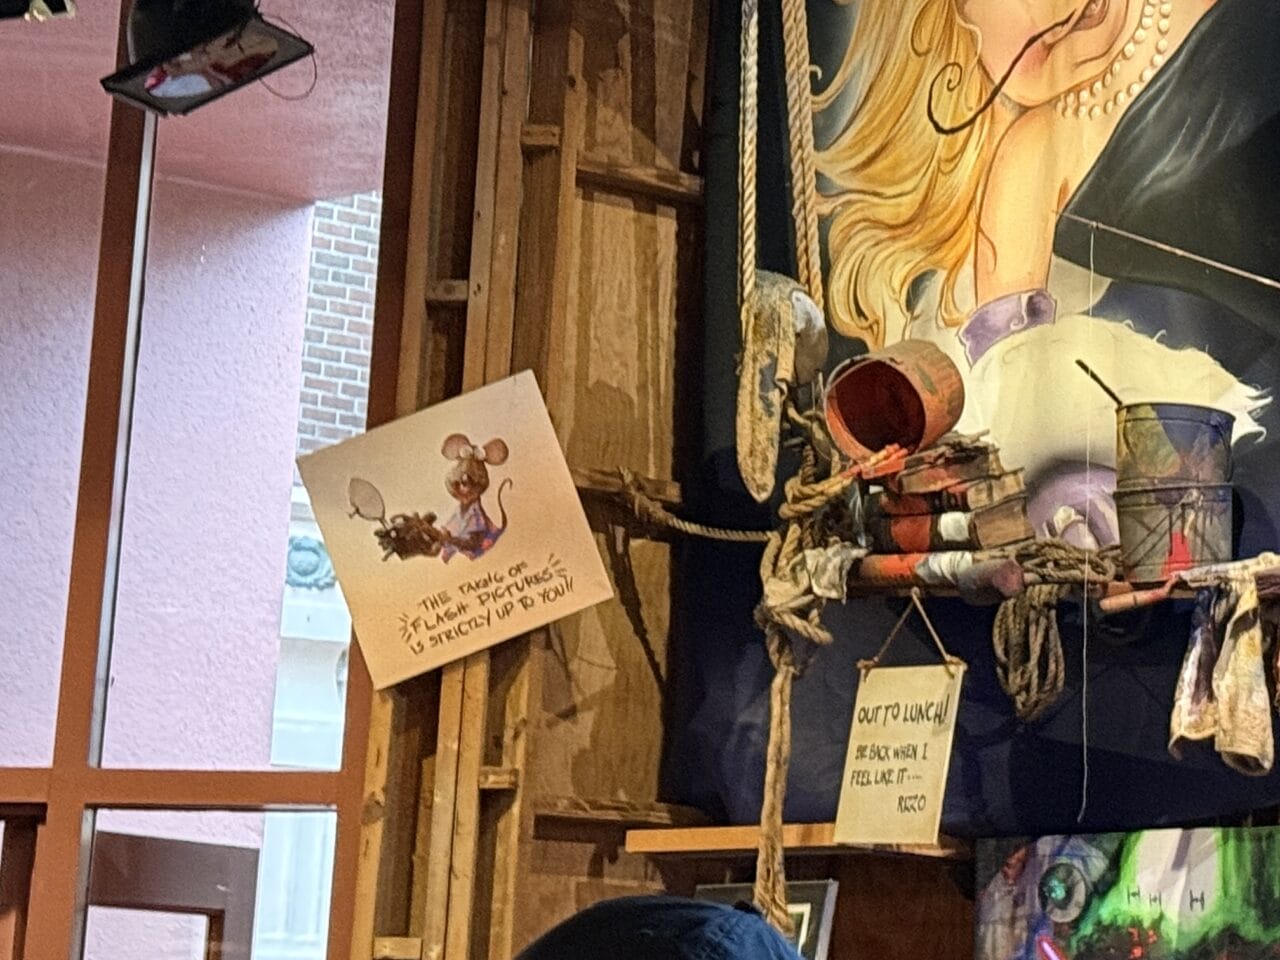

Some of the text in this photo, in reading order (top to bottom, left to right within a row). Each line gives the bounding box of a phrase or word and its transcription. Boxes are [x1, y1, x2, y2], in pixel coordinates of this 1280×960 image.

[410, 567, 553, 634] FLASH PICTURES
[419, 591, 451, 612] THE
[508, 560, 528, 577] OF
[410, 641, 424, 655] IS
[429, 608, 491, 648] STRICTLY
[496, 601, 514, 620] UP
[518, 595, 534, 611] TO
[858, 694, 950, 726] OUT TO LUNCH!
[869, 744, 890, 760] BACK
[893, 743, 917, 760] WHEN
[921, 743, 928, 760] I
[851, 770, 872, 787] FEEL
[874, 770, 894, 787] LIKE
